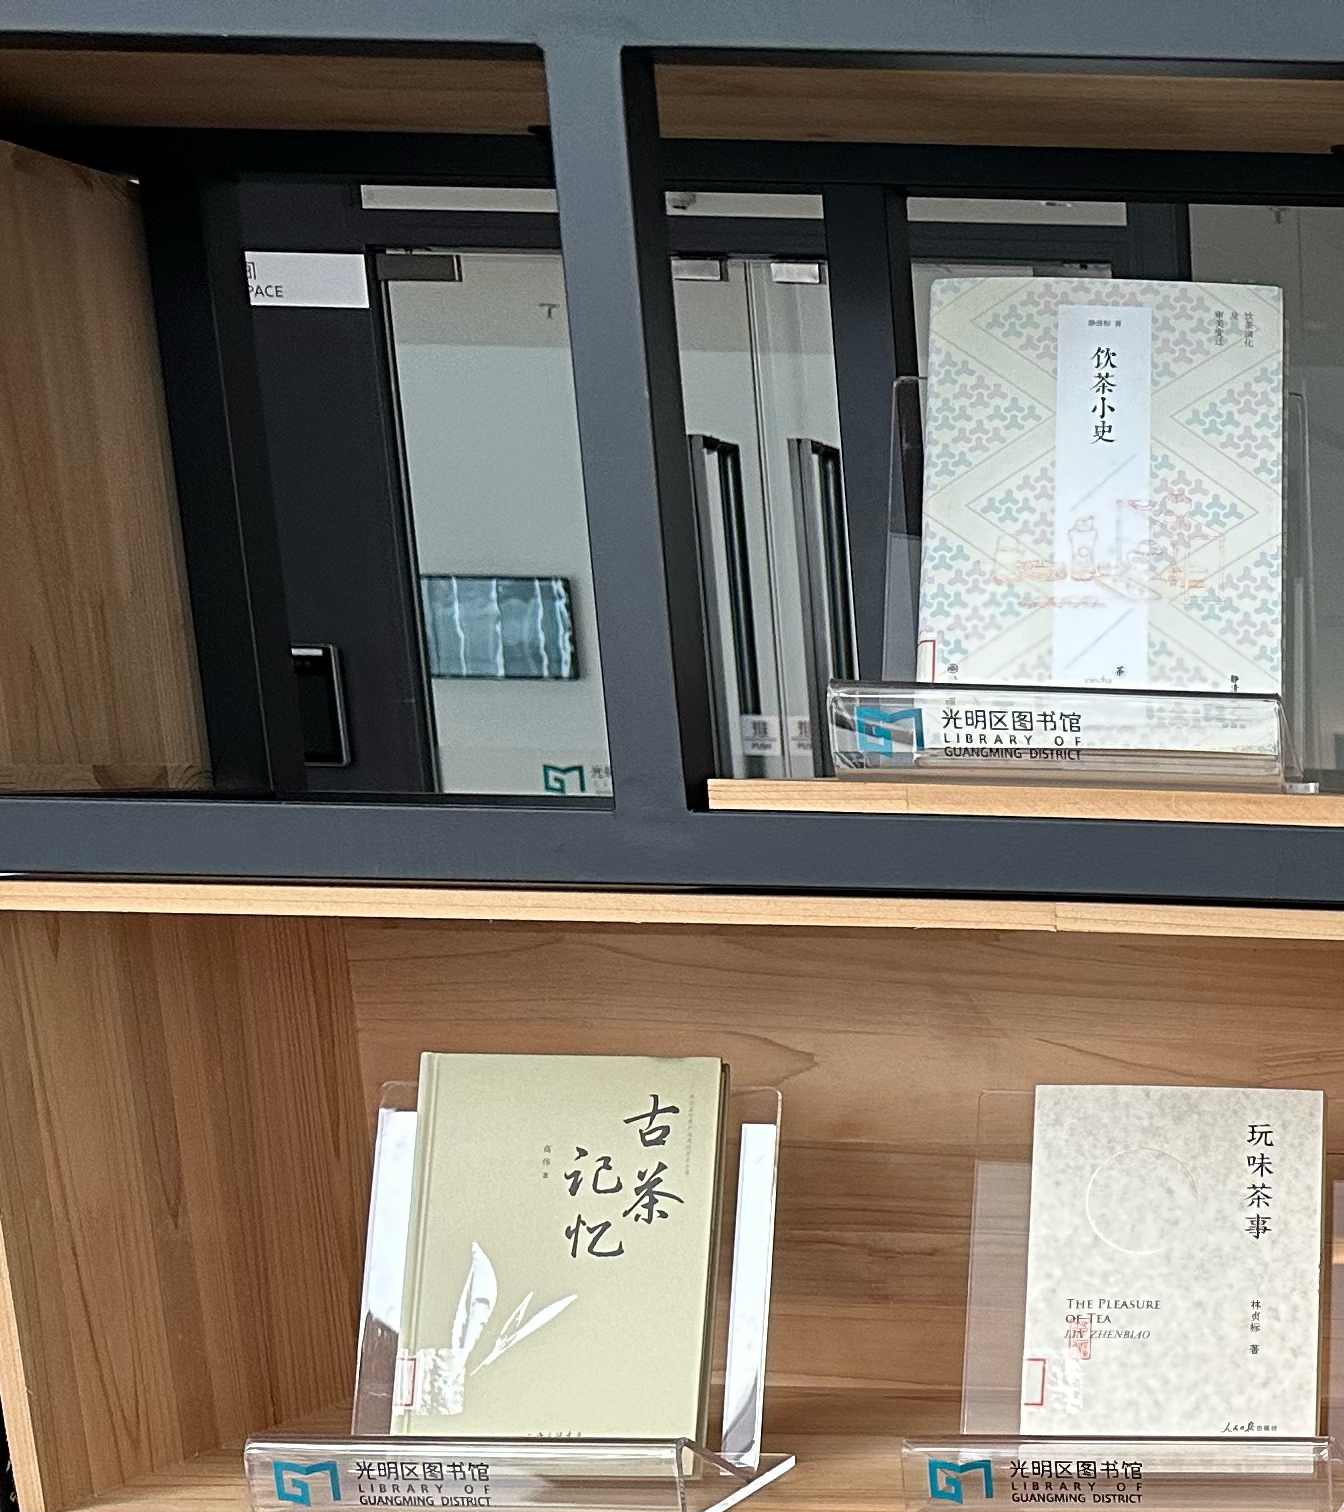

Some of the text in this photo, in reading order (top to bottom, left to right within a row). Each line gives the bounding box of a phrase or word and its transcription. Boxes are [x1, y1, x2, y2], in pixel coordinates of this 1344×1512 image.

[1089, 346, 1118, 445] 饮茶小史
[941, 708, 1082, 733] 光明区图书馆
[944, 734, 1082, 746] LIBRARY OF
[944, 746, 1082, 761] GUANGMING DISTRICT
[622, 1093, 685, 1225] 古茶
[1244, 1122, 1275, 1240] 玩味茶事
[563, 1145, 625, 1259] 记忆
[1249, 1299, 1261, 1333] 林贞标
[356, 1461, 490, 1481] 光明区图书馆
[1009, 1460, 1143, 1479] 光明区图书馆
[358, 1483, 491, 1494] LIBRARY OF
[1011, 1481, 1142, 1492] LIBRARY OF
[359, 1495, 491, 1507] GUANGMING DISTRICT
[1011, 1492, 1143, 1504] GUANGMING DISTRICT
